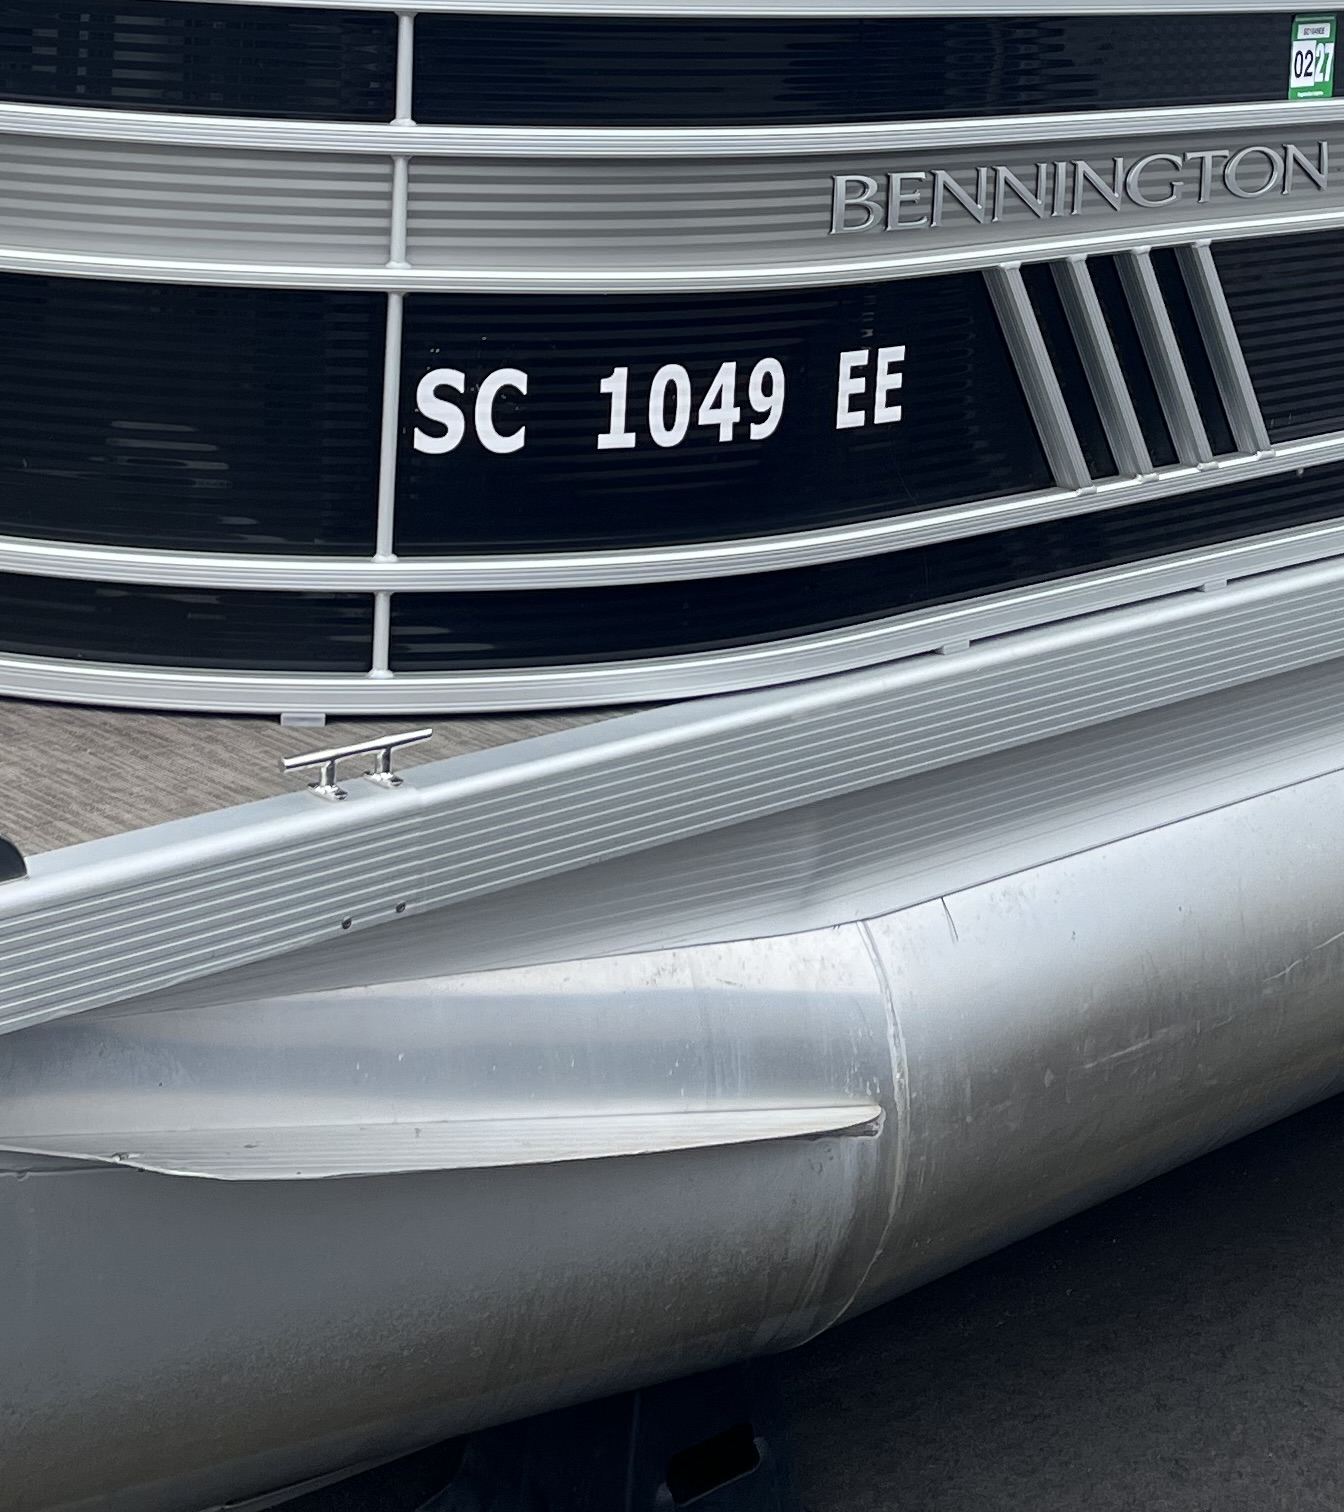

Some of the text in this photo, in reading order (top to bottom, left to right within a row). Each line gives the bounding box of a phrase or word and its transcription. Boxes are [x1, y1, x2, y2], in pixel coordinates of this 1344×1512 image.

[1294, 43, 1334, 82] 02 27
[828, 140, 1329, 236] BENNINGTON
[413, 345, 906, 455] SC 1049 EE
